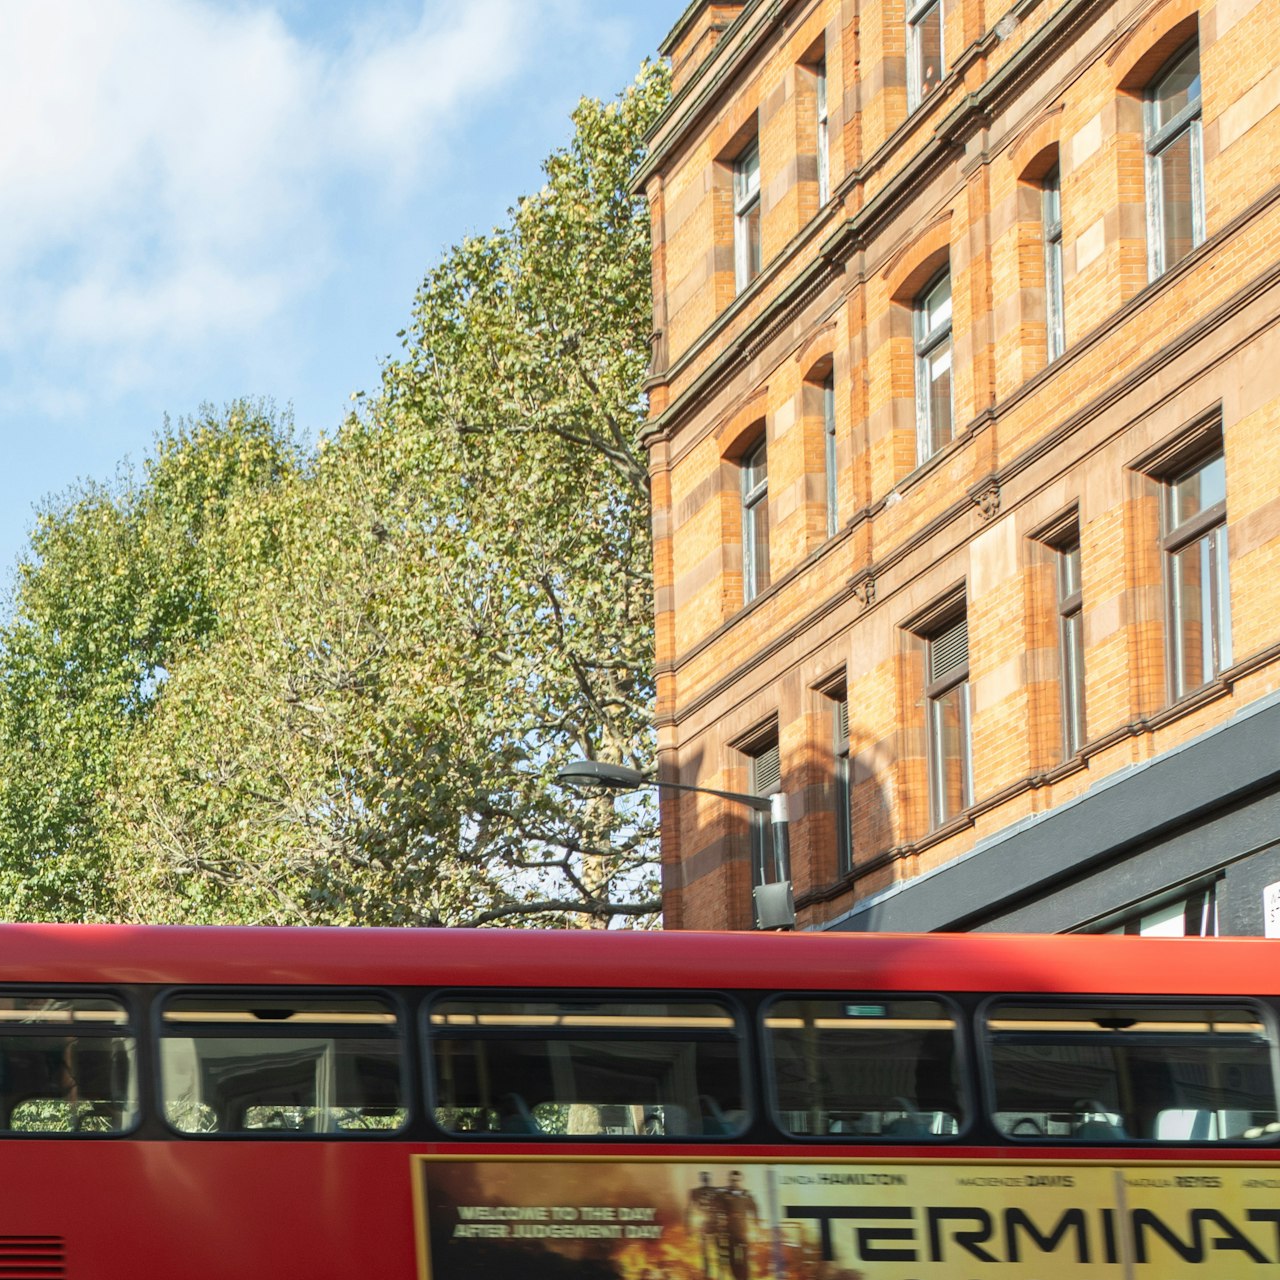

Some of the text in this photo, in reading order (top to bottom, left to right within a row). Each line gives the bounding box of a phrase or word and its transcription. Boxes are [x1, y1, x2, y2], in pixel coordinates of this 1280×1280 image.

[457, 1206, 658, 1221] WELCOME TO THE DAY
[453, 1224, 664, 1239] AFTER JUDGEMENT DAY
